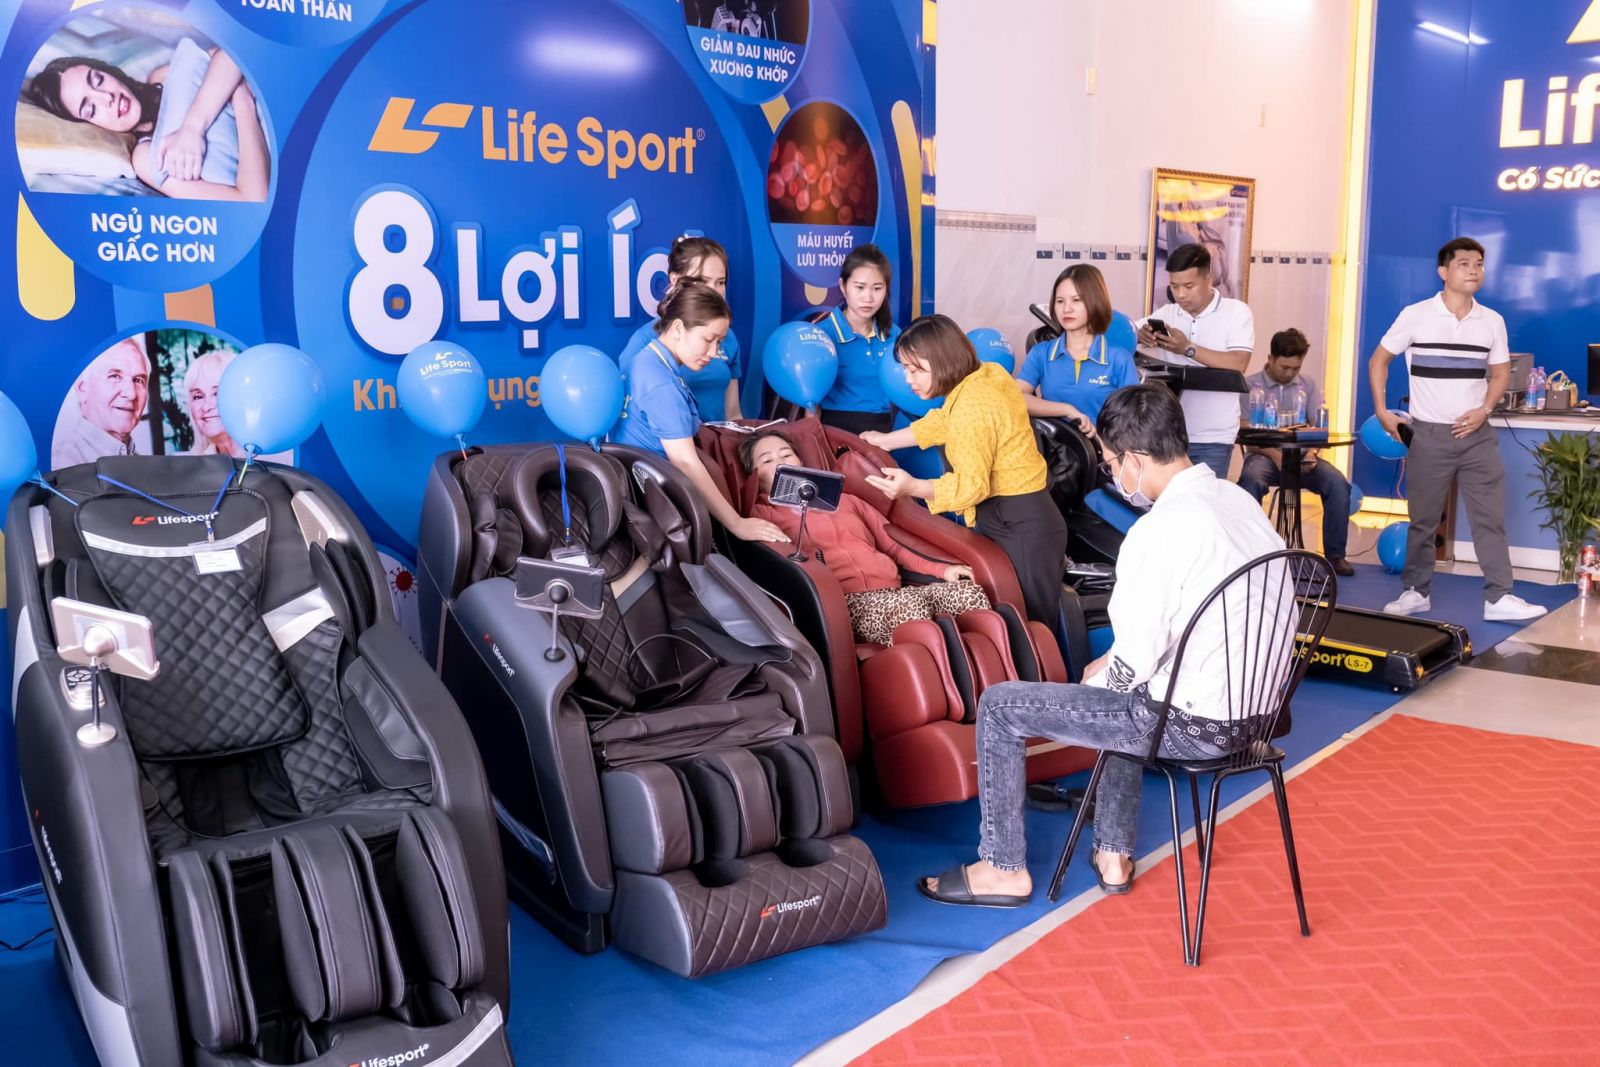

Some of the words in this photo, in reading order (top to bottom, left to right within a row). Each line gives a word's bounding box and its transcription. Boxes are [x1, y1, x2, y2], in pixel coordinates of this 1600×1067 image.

[700, 34, 734, 55] GIẢM
[737, 42, 760, 60] ĐAU
[763, 45, 797, 65] NHỨC
[709, 58, 754, 78] XƯƠNG
[757, 62, 789, 83] KHỚP
[1499, 72, 1600, 149] Lif
[481, 106, 569, 165] Life
[1497, 166, 1542, 191] Có
[90, 206, 143, 235] NGỦ
[150, 214, 218, 236] NGON
[97, 235, 160, 263] GIẤC
[166, 243, 216, 263] HƠN
[797, 231, 821, 248] MÁU
[823, 230, 854, 249] HUYẾT
[348, 190, 444, 356] 8
[456, 229, 581, 350] Lợi
[612, 205, 696, 320] Íc
[796, 251, 816, 267] LƯU
[818, 250, 846, 267] THÔN
[352, 377, 398, 412] Kh
[487, 375, 542, 410] ụng
